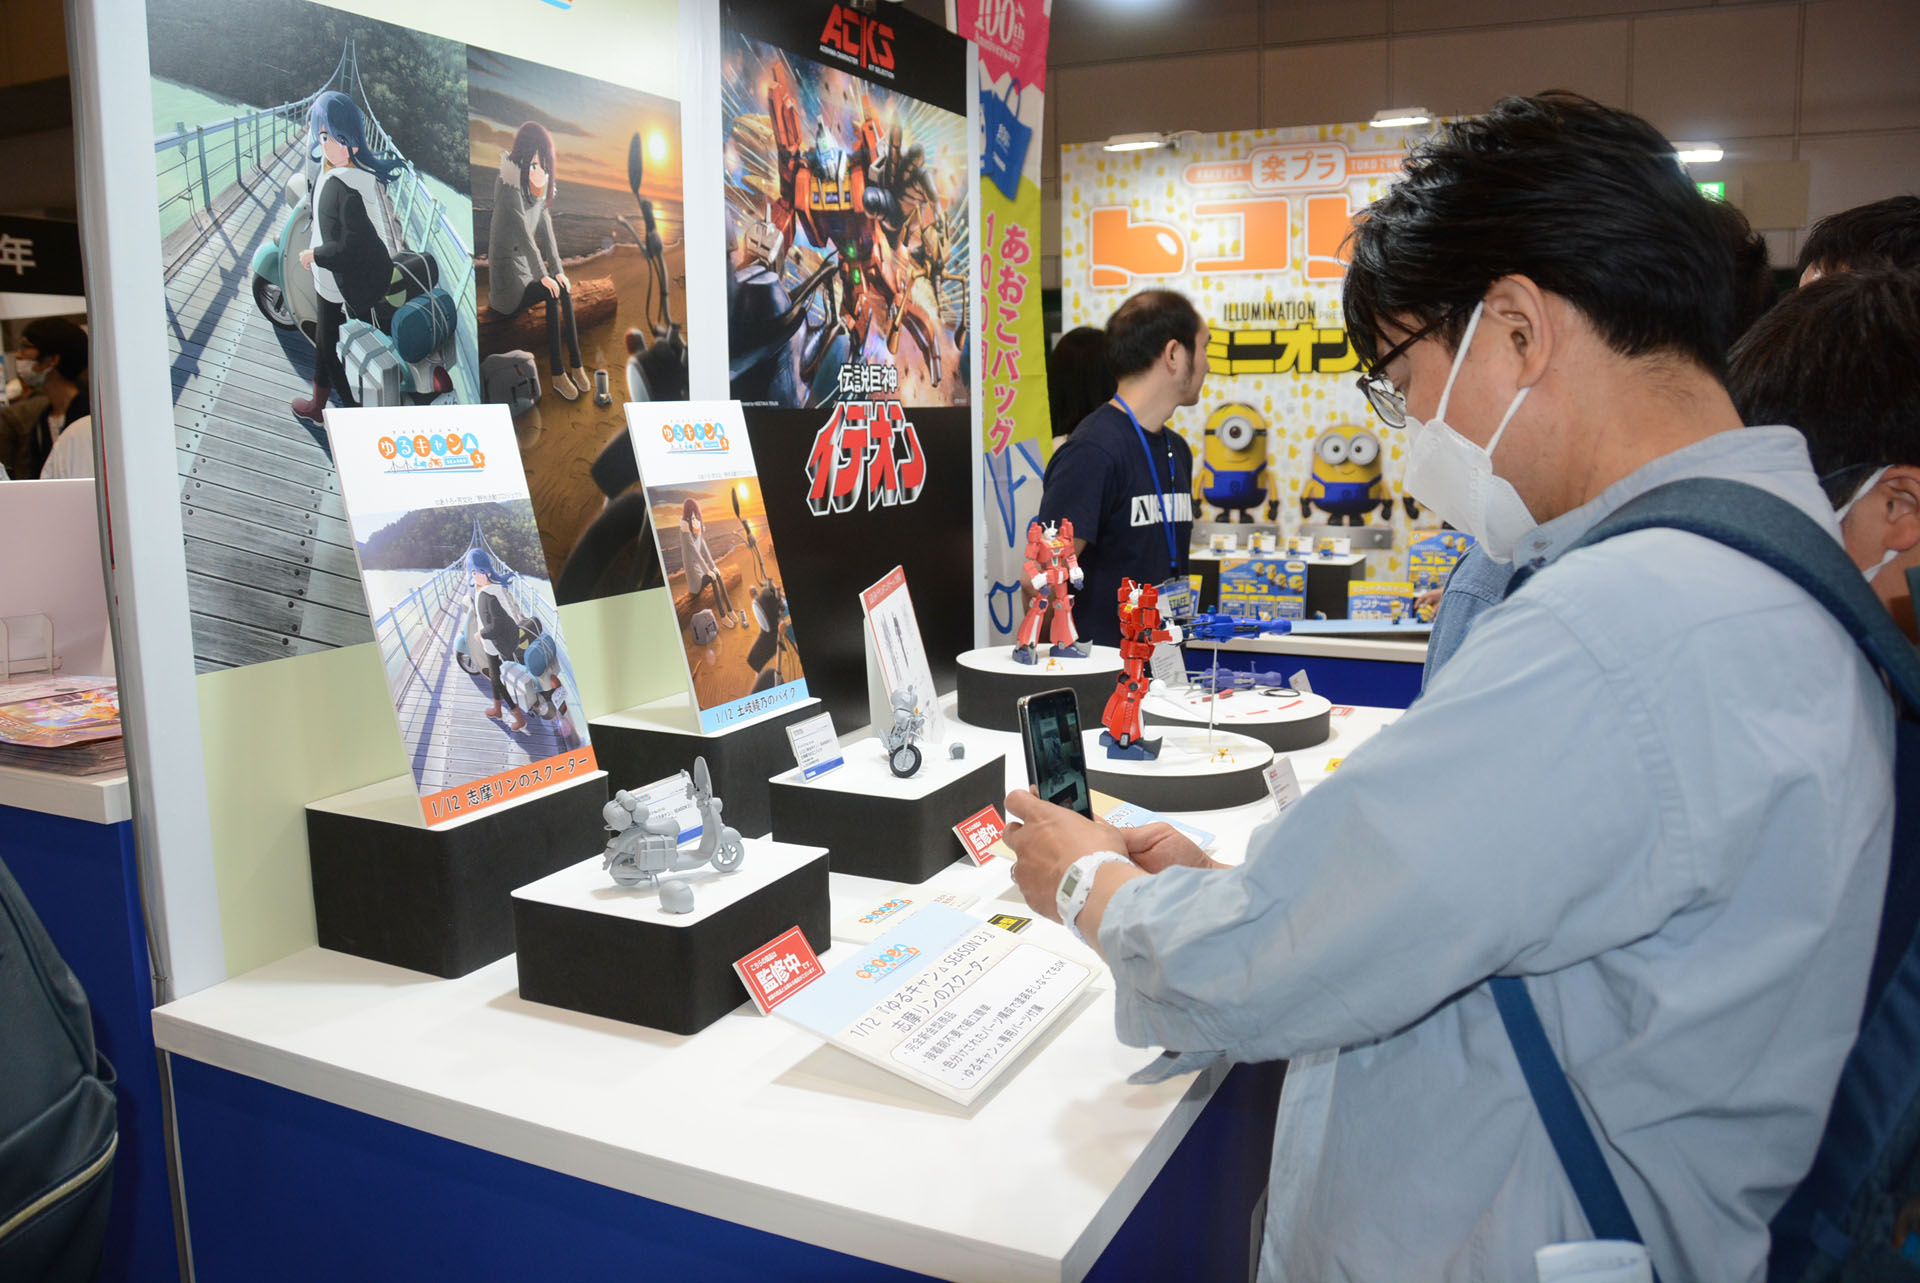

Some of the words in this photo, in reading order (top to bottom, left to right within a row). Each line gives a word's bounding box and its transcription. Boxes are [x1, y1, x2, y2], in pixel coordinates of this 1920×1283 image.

[1261, 151, 1336, 183] 楽プラ
[989, 223, 1031, 456] あおこバッグ
[1223, 301, 1317, 322] ILLUMINATION
[1207, 322, 1370, 376] ミニオン
[837, 364, 898, 393] 伝説巨神
[805, 401, 927, 516] イデオン
[715, 710, 734, 724] 1/12
[432, 795, 461, 817] 1/12
[466, 757, 589, 807] 志摩リンのスクーター
[850, 1016, 881, 1039] 1/12
[944, 939, 976, 967] SEASON
[891, 954, 990, 1034] 志摩リンのスクーター
